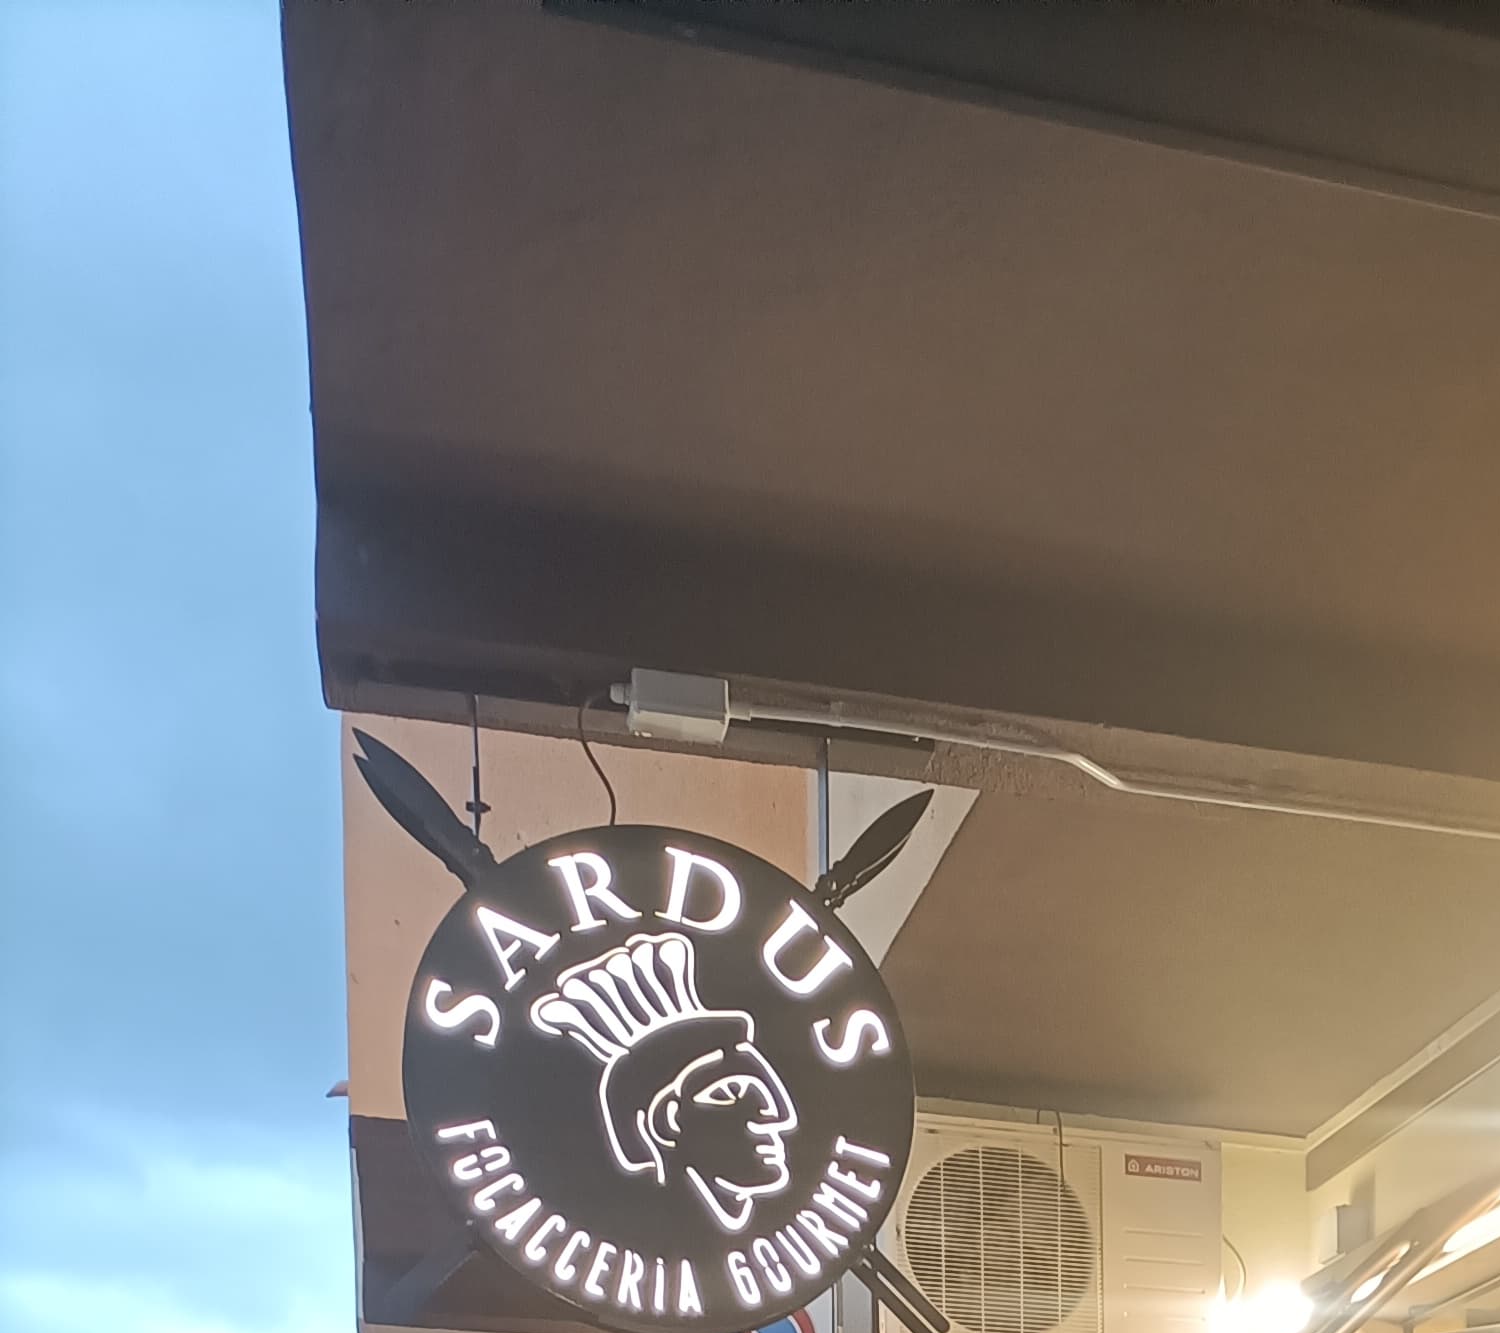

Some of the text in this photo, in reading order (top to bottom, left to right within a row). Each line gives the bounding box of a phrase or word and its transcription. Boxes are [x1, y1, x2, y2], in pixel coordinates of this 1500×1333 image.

[425, 846, 889, 1064] SARDUS
[726, 1134, 891, 1305] GOURMET
[1144, 1163, 1199, 1178] ARISTON
